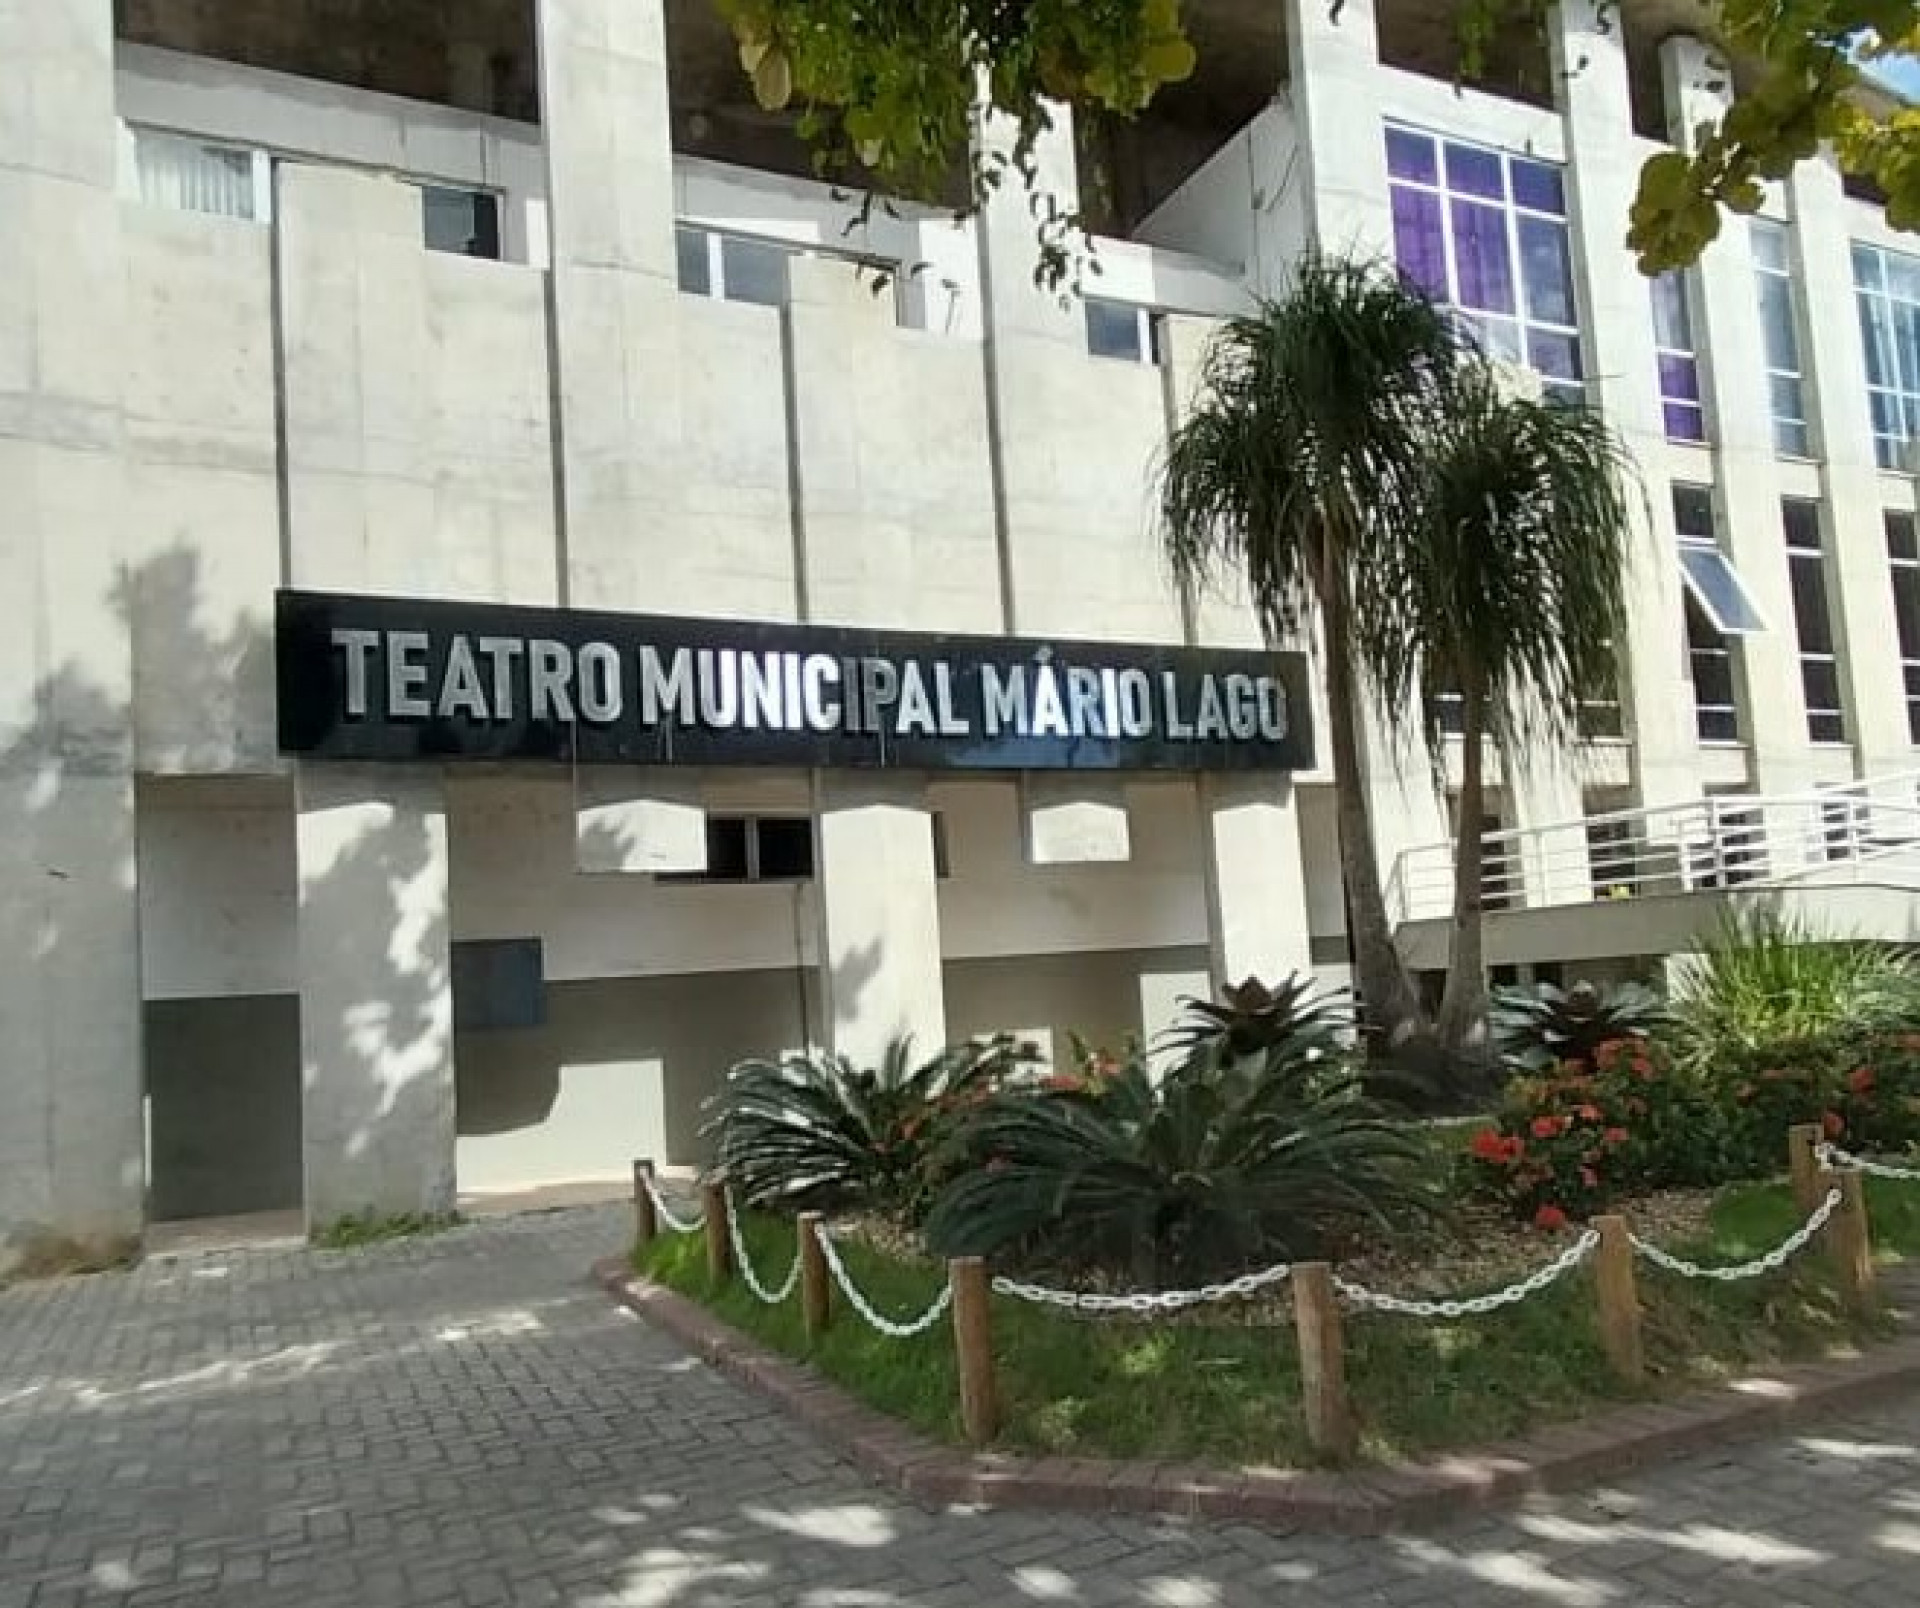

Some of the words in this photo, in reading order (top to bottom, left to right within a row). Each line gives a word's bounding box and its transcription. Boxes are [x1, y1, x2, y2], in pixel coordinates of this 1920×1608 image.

[332, 629, 623, 723] TEATRO
[640, 645, 969, 735] MUNICIPAL
[981, 646, 1154, 738] MÁRIO
[1162, 671, 1287, 742] LAGO
